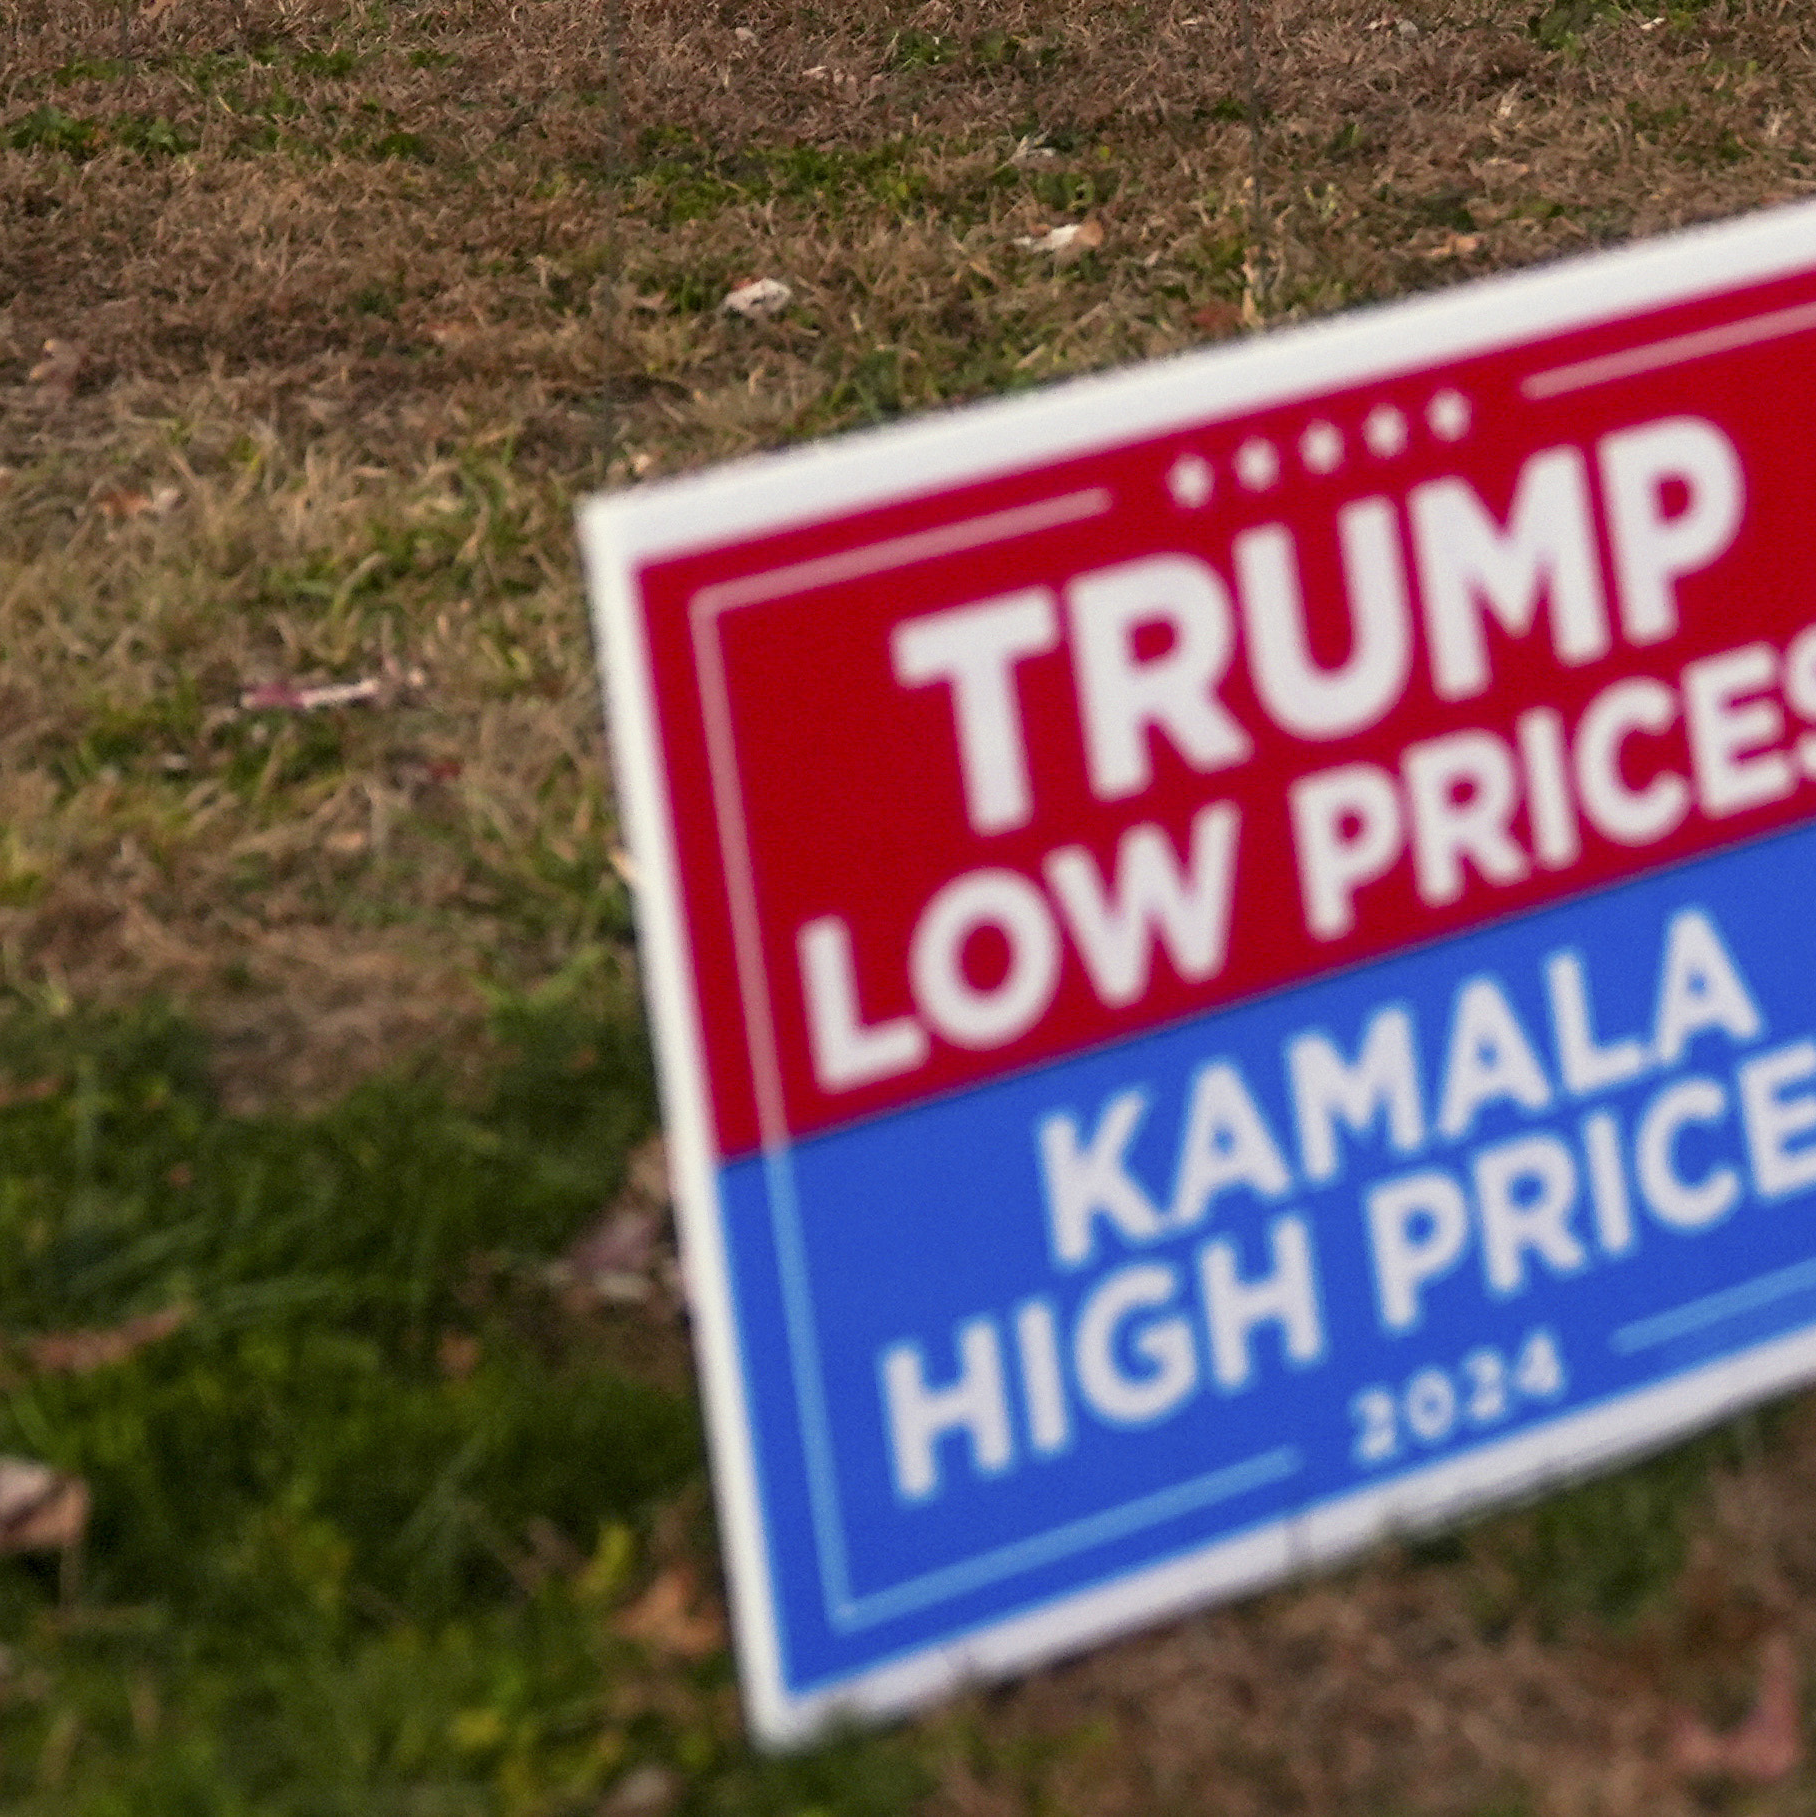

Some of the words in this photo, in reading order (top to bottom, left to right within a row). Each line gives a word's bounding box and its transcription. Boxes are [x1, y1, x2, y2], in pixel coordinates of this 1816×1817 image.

[890, 416, 1747, 836] TRUMP
[796, 803, 1241, 1095] LOW
[1038, 908, 1761, 1269] KAMALA
[880, 1215, 1326, 1504] HIGH
[1349, 1332, 1568, 1464] 2024
